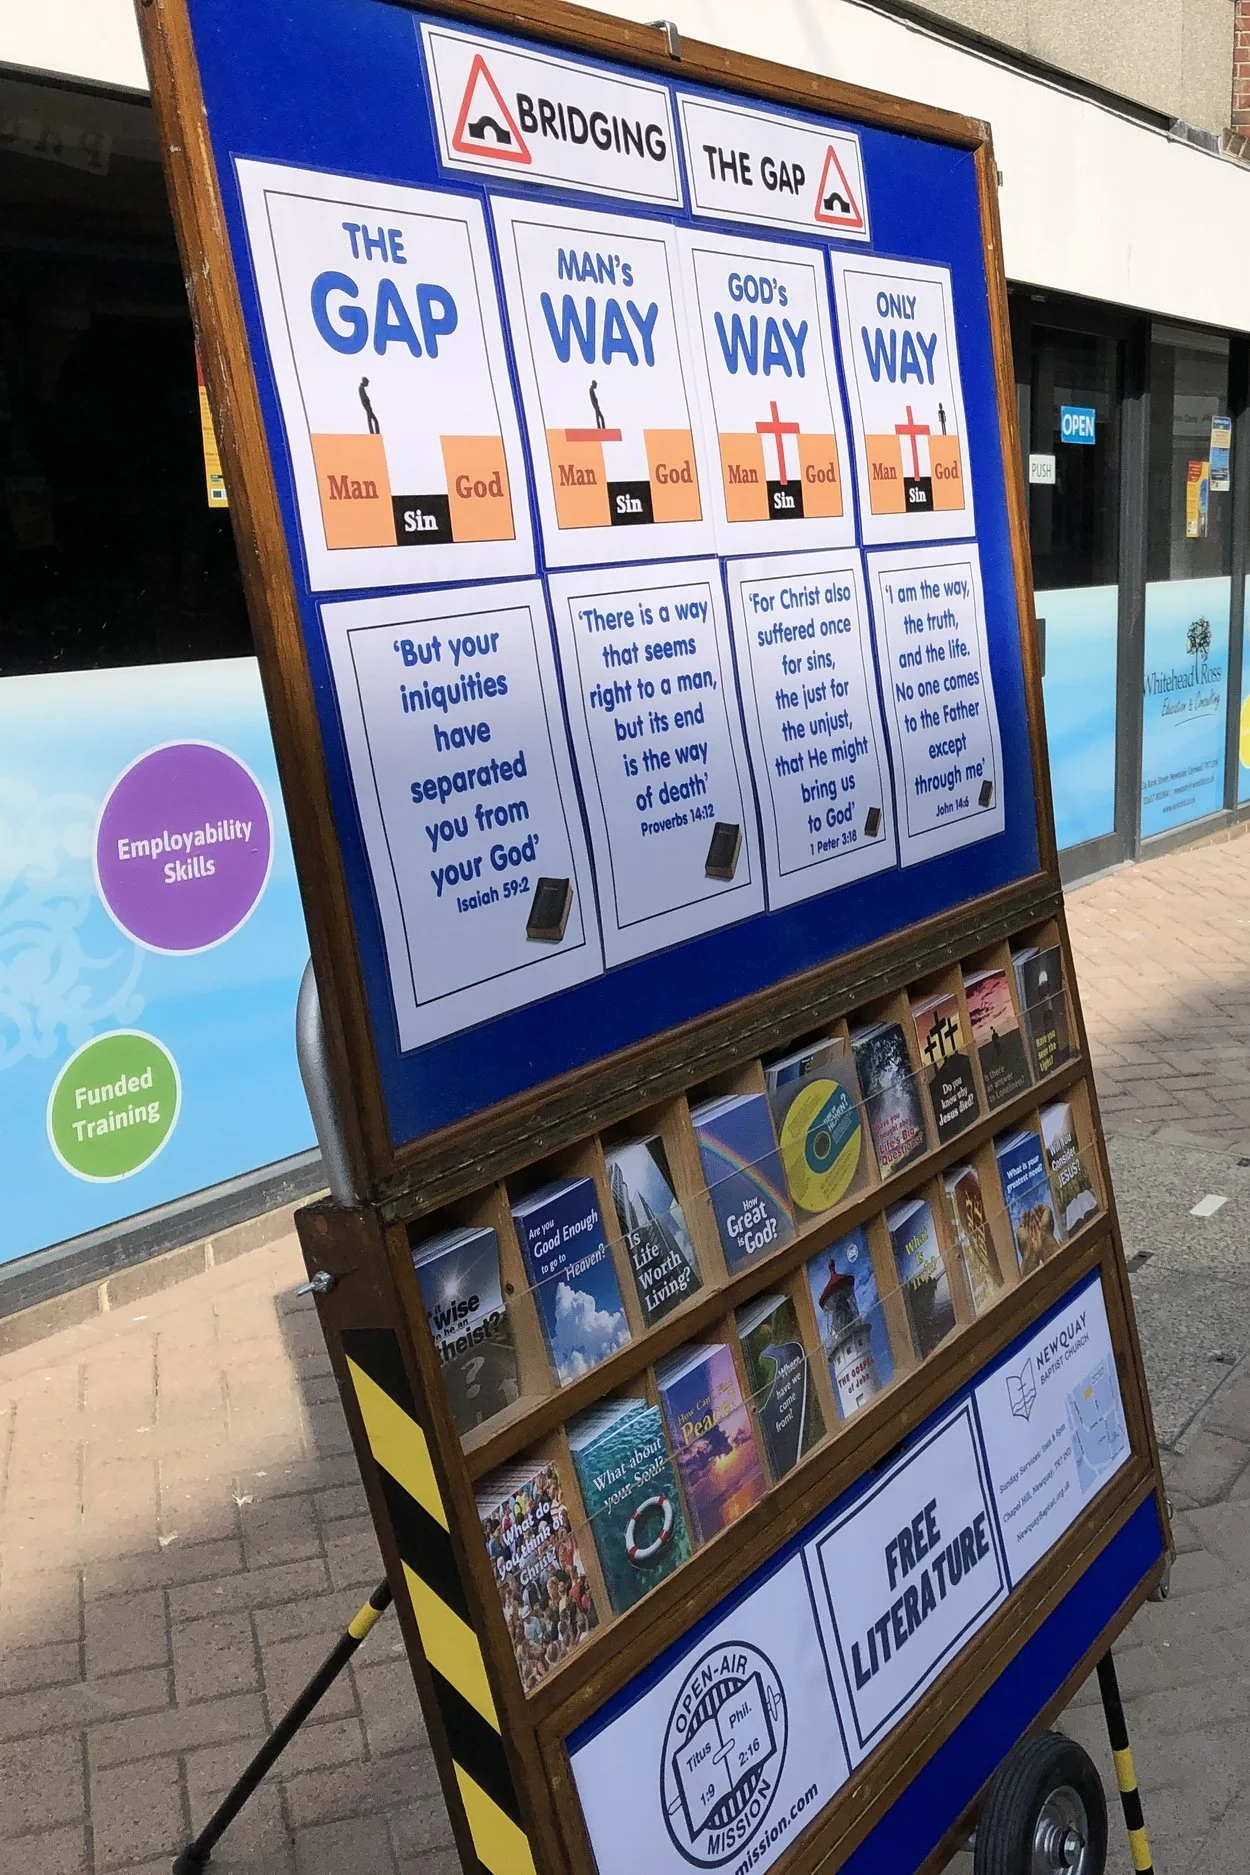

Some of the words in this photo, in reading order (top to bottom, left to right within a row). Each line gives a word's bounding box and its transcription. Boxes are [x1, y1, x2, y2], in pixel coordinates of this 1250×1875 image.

[516, 92, 668, 161] BRIDGING
[703, 146, 754, 188] THE
[759, 154, 806, 195] GAP
[342, 222, 406, 264] THE
[558, 248, 632, 288] MAN's
[728, 272, 788, 306] GOD's
[311, 270, 458, 359] GAP
[877, 292, 916, 319] ONLY
[541, 294, 658, 367] WAY
[714, 311, 808, 378] WAY
[861, 326, 938, 385] WAY
[1062, 414, 1094, 436] OPEN
[559, 464, 597, 487] Man
[654, 461, 692, 485] God
[872, 462, 896, 480] Man
[934, 460, 959, 480] God
[1032, 463, 1051, 477] PUSH
[327, 476, 379, 500] Man
[455, 473, 503, 499] God
[908, 487, 926, 504] Sin
[616, 494, 642, 514] Sin
[403, 509, 438, 532] Sin
[780, 586, 820, 609] Christ
[825, 583, 851, 604] also
[898, 587, 917, 603] am
[920, 580, 940, 599] the
[944, 579, 970, 599] way,
[639, 603, 653, 625] is
[659, 606, 670, 623] a
[675, 601, 707, 623] way
[904, 615, 924, 635] the
[927, 608, 959, 631] truth,
[758, 618, 815, 647] suffered
[820, 617, 851, 637] once
[448, 632, 499, 666] your
[603, 642, 638, 668] that
[645, 637, 696, 662] seems
[400, 671, 508, 714] iniquities
[1144, 666, 1194, 697] Whitehead
[1201, 663, 1221, 685] Ross
[1161, 698, 1186, 717] Education
[1194, 688, 1220, 711] Consulting
[434, 721, 491, 752] have
[411, 750, 528, 804] separated
[641, 812, 688, 837] Proverbs
[690, 804, 715, 823] 14:12
[936, 803, 953, 817] John
[955, 796, 969, 811] 14:6
[118, 819, 253, 860] Employability
[426, 816, 468, 852] you
[475, 800, 529, 832] from
[810, 843, 815, 855] 1
[817, 836, 840, 854] Peter
[841, 830, 857, 845] 3:18
[164, 856, 215, 884] Skills
[431, 856, 482, 897] your
[457, 886, 499, 913] Isaiah
[503, 876, 530, 900] 59:2
[75, 1066, 154, 1109] Funded
[941, 1096, 957, 1109] know
[957, 1087, 967, 1097] why
[942, 1084, 952, 1094] Do
[952, 1077, 962, 1089] you
[72, 1100, 161, 1142] Training
[939, 1109, 958, 1126] Jesus
[959, 1093, 974, 1113] died?
[1006, 1165, 1022, 1179] What
[1022, 1161, 1028, 1171] is
[1028, 1156, 1039, 1170] your
[1052, 1147, 1076, 1171] Consider
[1059, 1159, 1081, 1188] JESUS?
[1007, 1175, 1028, 1194] greatest
[1029, 1163, 1043, 1179] need?
[727, 1201, 767, 1237] Great
[743, 1197, 758, 1210] How
[529, 1226, 541, 1240] Are
[541, 1218, 555, 1236] you
[534, 1235, 561, 1258] Good
[563, 1209, 598, 1240] Enough
[628, 1232, 641, 1249] Is
[737, 1237, 745, 1247] is
[745, 1217, 778, 1253] God?
[905, 1227, 928, 1255] What
[541, 1264, 548, 1275] to
[550, 1259, 559, 1274] go
[559, 1253, 566, 1264] to
[565, 1243, 606, 1281] Heaven?
[633, 1245, 659, 1271] Life
[639, 1252, 682, 1290] Worth
[645, 1266, 691, 1311] Living?
[433, 1295, 480, 1330] wise
[1036, 1311, 1087, 1370] NEWQUAY
[778, 1356, 801, 1380] Where
[838, 1373, 850, 1388] THE
[852, 1356, 873, 1377] GOSPEL
[1040, 1349, 1065, 1385] BAPTIST
[1065, 1332, 1090, 1361] CHURCH
[776, 1381, 791, 1400] have
[791, 1372, 801, 1385] we
[848, 1383, 854, 1393] of
[856, 1374, 870, 1388] John
[678, 1410, 694, 1425] How
[696, 1396, 711, 1410] Can
[779, 1392, 797, 1413] come
[775, 1408, 794, 1432] from?
[592, 1462, 626, 1494] What
[630, 1438, 662, 1468] about
[604, 1483, 632, 1514] your
[633, 1456, 666, 1486] Soul?
[1000, 1473, 1019, 1494] Sunday
[502, 1516, 535, 1547] What
[536, 1501, 550, 1520] do
[1003, 1500, 1021, 1523] Chapel
[497, 1553, 520, 1582] you
[520, 1528, 550, 1566] think
[552, 1515, 564, 1532] of
[885, 1498, 941, 1591] FREE
[519, 1547, 556, 1586] Christ?
[851, 1512, 990, 1691] LITERATURE
[676, 1654, 747, 1733] OPEN-AIR
[729, 1702, 752, 1728] Phil.
[686, 1742, 712, 1773] Titus
[738, 1738, 760, 1767] 2:16
[701, 1784, 715, 1806] 1:9
[708, 1779, 771, 1855] MISSION
